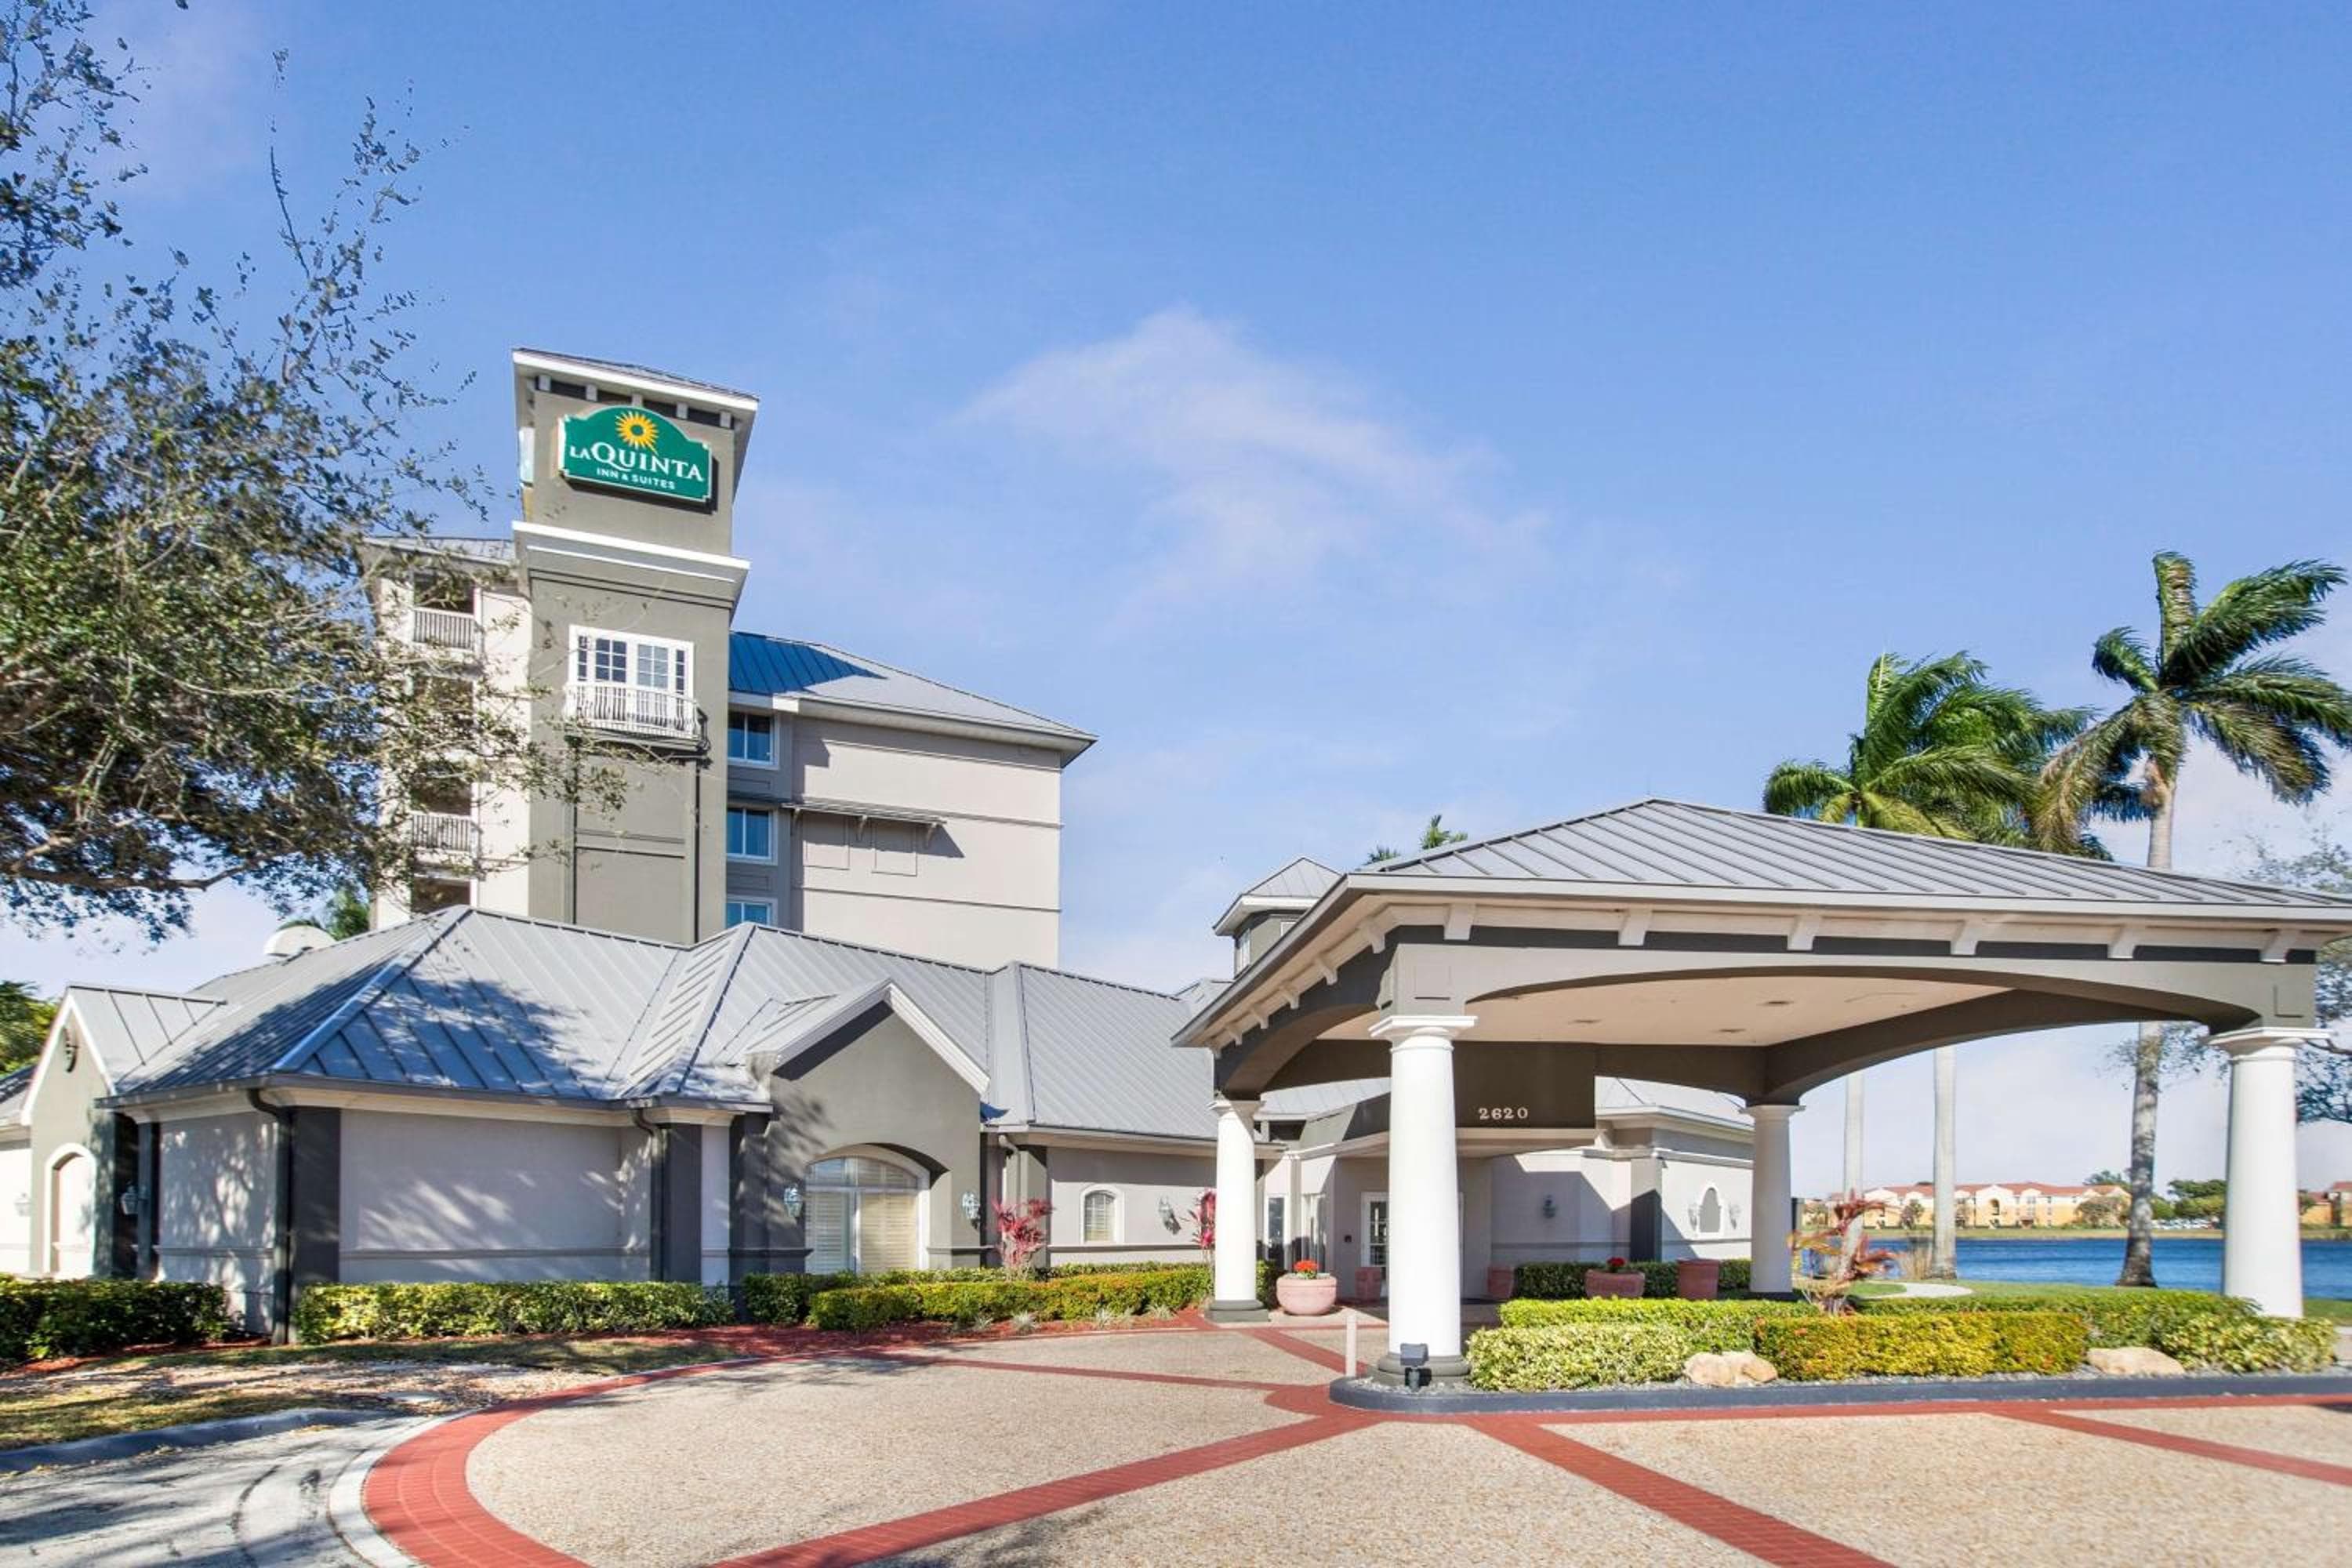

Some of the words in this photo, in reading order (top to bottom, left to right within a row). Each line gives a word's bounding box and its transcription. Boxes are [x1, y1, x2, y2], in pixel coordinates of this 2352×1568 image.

[570, 445, 592, 460] LA
[591, 441, 704, 481] QUINTA
[597, 467, 619, 479] INN
[631, 474, 676, 490] SUITES
[1479, 1107, 1528, 1120] 2620
